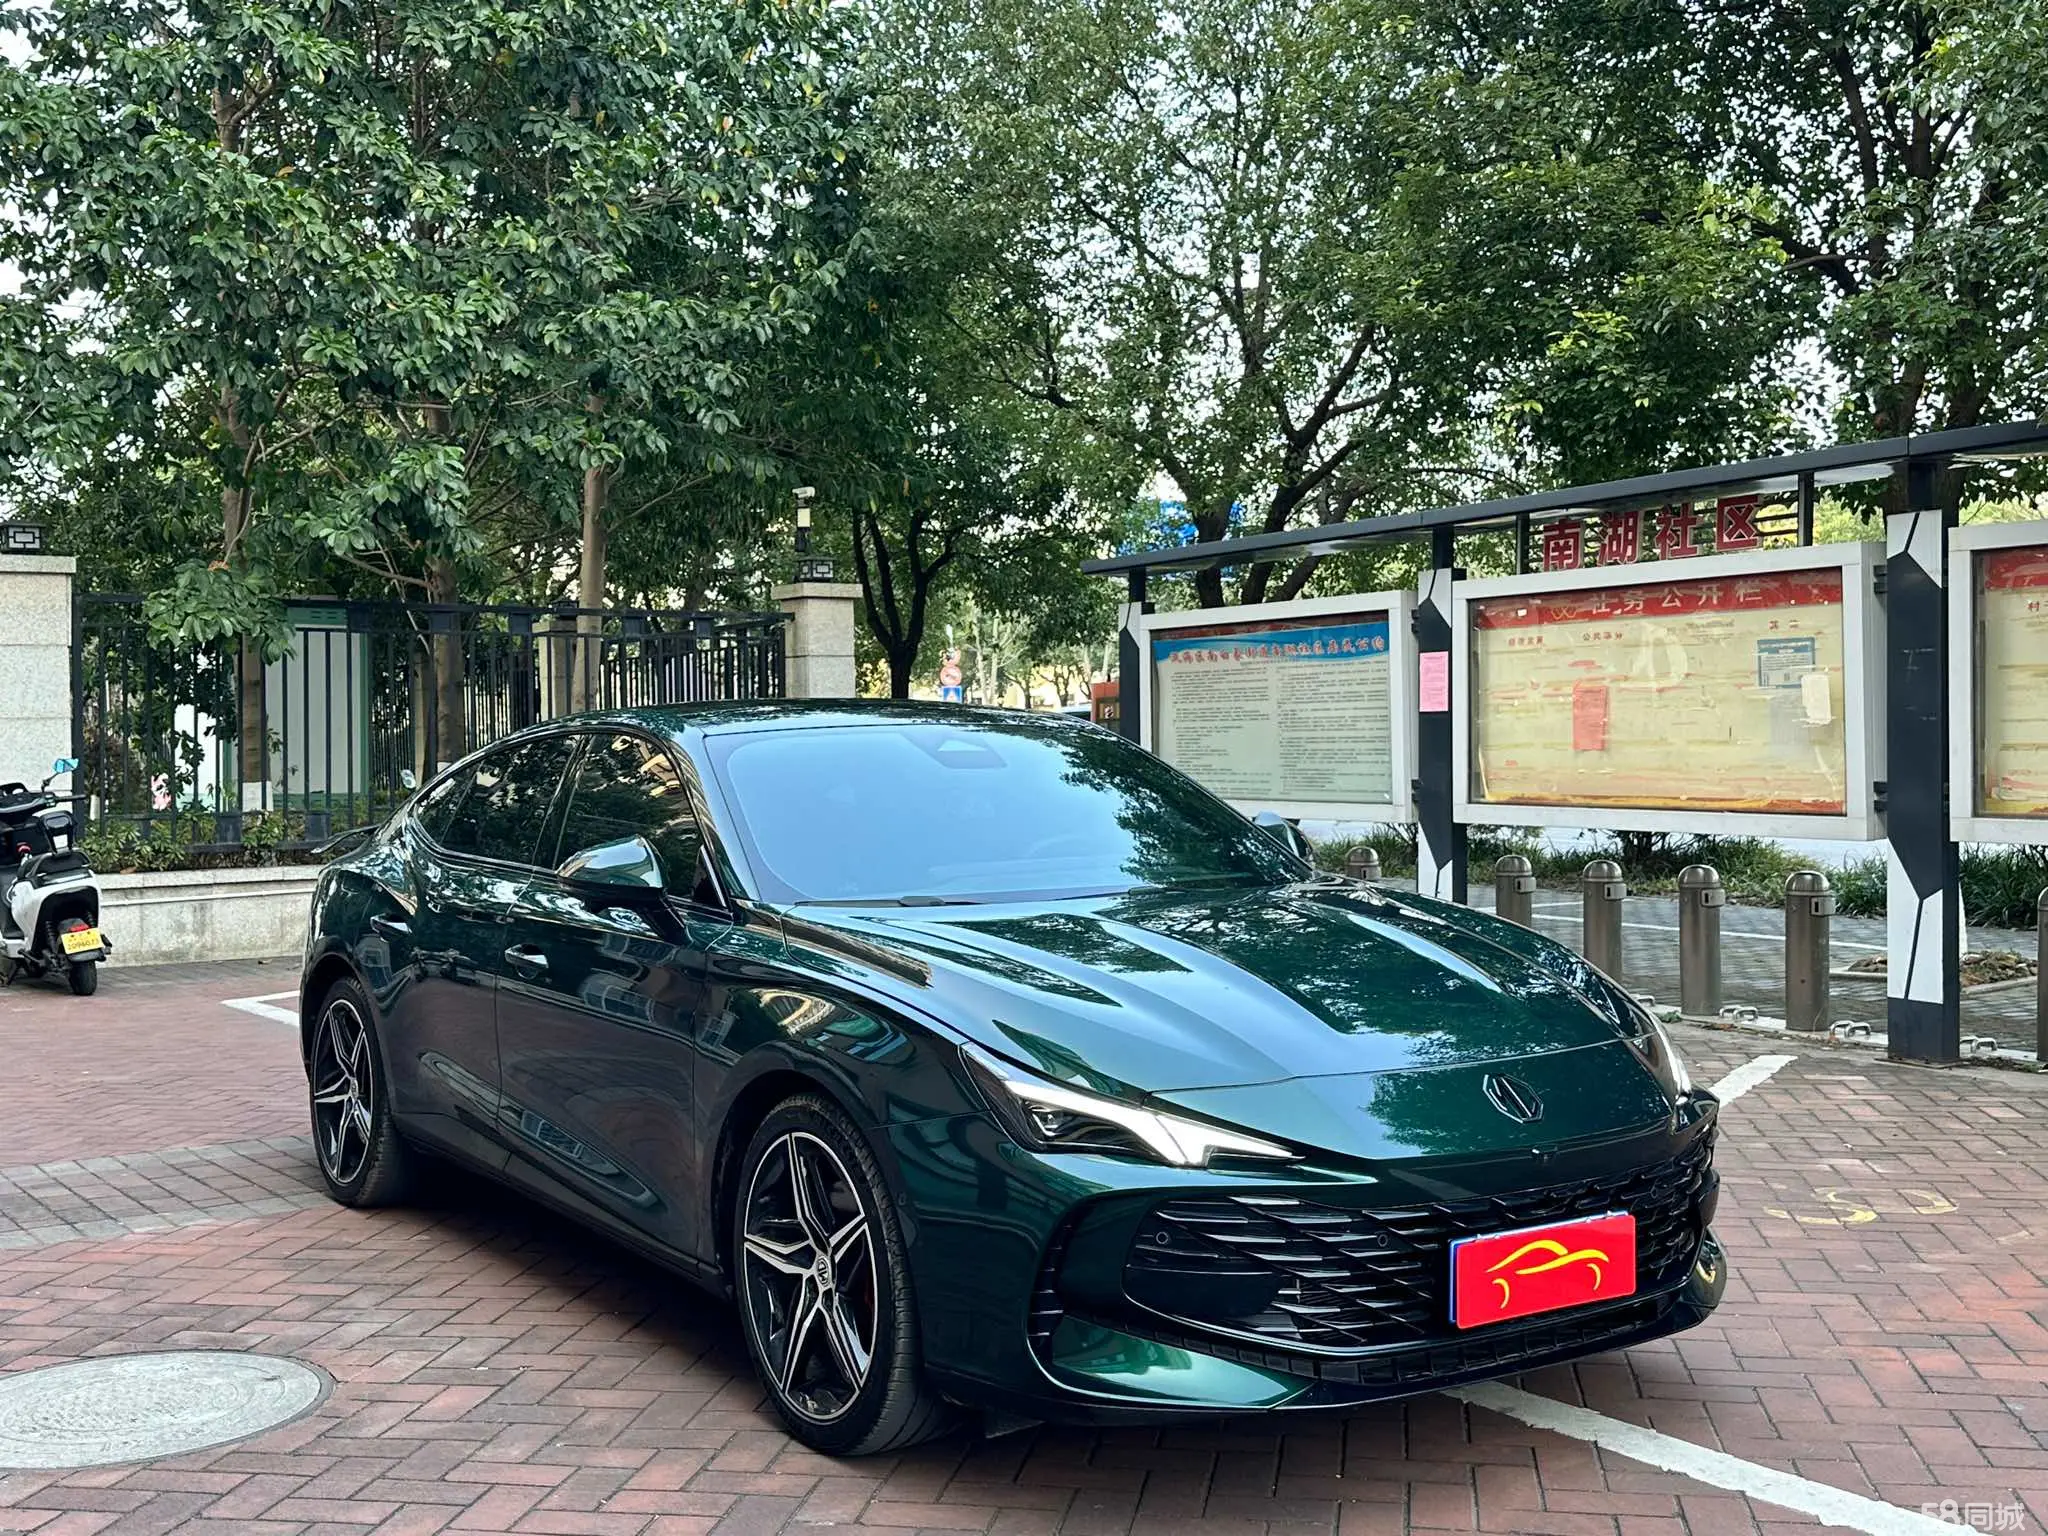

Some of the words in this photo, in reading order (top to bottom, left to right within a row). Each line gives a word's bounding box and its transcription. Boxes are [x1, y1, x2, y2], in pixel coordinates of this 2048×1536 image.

[1542, 495, 1763, 572] 南湖社区
[1590, 580, 1763, 614] 社务公开栏
